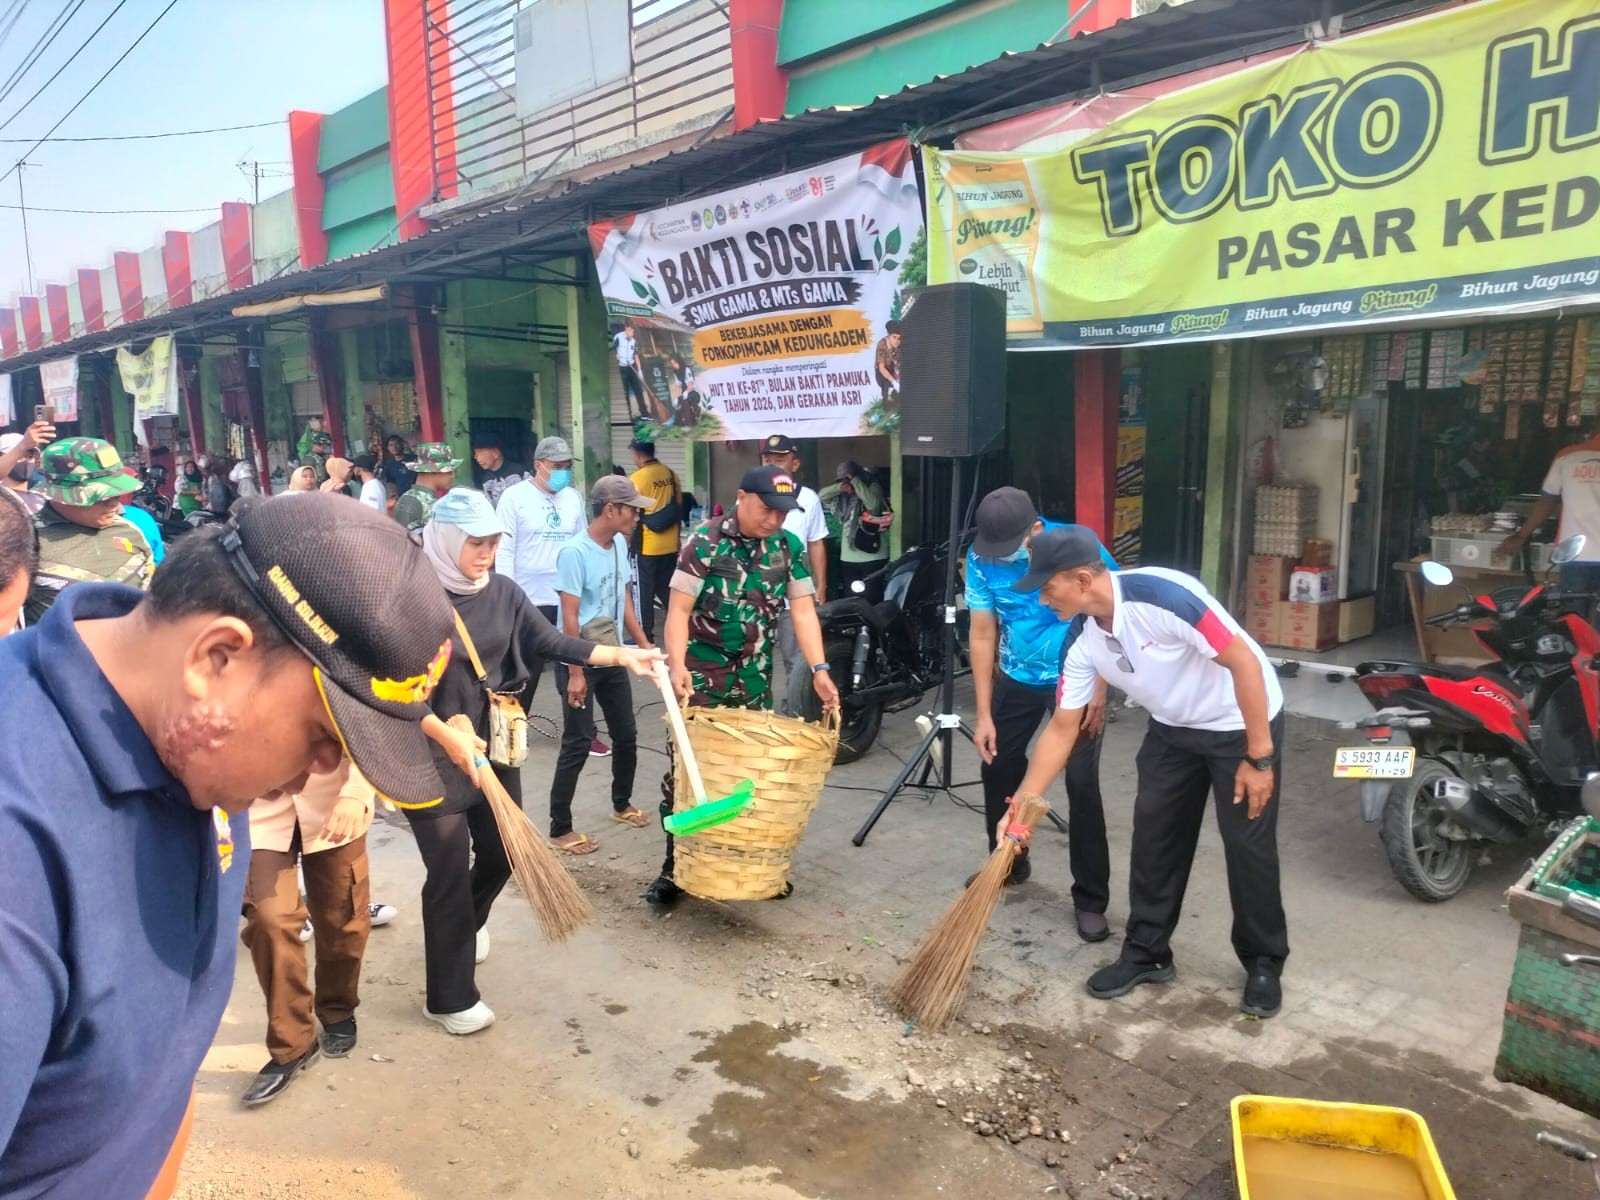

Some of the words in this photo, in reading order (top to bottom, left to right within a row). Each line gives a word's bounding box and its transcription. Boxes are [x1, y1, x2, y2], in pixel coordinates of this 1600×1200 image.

[1070, 62, 1443, 237] TOKO
[1217, 207, 1417, 280] PASAR
[658, 236, 748, 304] BAKTI
[746, 218, 874, 279] SOSIAL
[979, 262, 1013, 279] Lebih
[690, 303, 718, 325] SMK
[720, 291, 755, 316] GAMA
[760, 289, 771, 308] &
[771, 284, 800, 306] MTs
[802, 281, 848, 304] GAMA
[1080, 326, 1114, 338] Bihun
[1116, 322, 1165, 337] Jagung
[1170, 309, 1229, 335] Pitung!
[1245, 308, 1288, 321] Bihun
[1292, 299, 1352, 317] Jagung
[1359, 283, 1438, 315] Pitung!
[1459, 281, 1518, 298] Bihun
[1524, 270, 1600, 291] Jagung
[701, 342, 781, 362] FORKOPIMCAM
[783, 328, 868, 352] KEDUNGADEM
[719, 321, 788, 342] BEKERJASAMA
[788, 314, 833, 332] DENGAN
[708, 382, 725, 397] HUT
[727, 380, 736, 395] RI
[768, 377, 797, 392] BULAN
[797, 373, 825, 390] BAKTI
[826, 370, 871, 390] PRAMUKA
[723, 398, 750, 413] TAHUN
[778, 394, 797, 409] DAN
[798, 391, 839, 408] GERAKAN
[841, 389, 863, 405] ASRI
[1340, 751, 1347, 763] S
[1352, 751, 1381, 763] 5933
[1385, 751, 1410, 763] AAF
